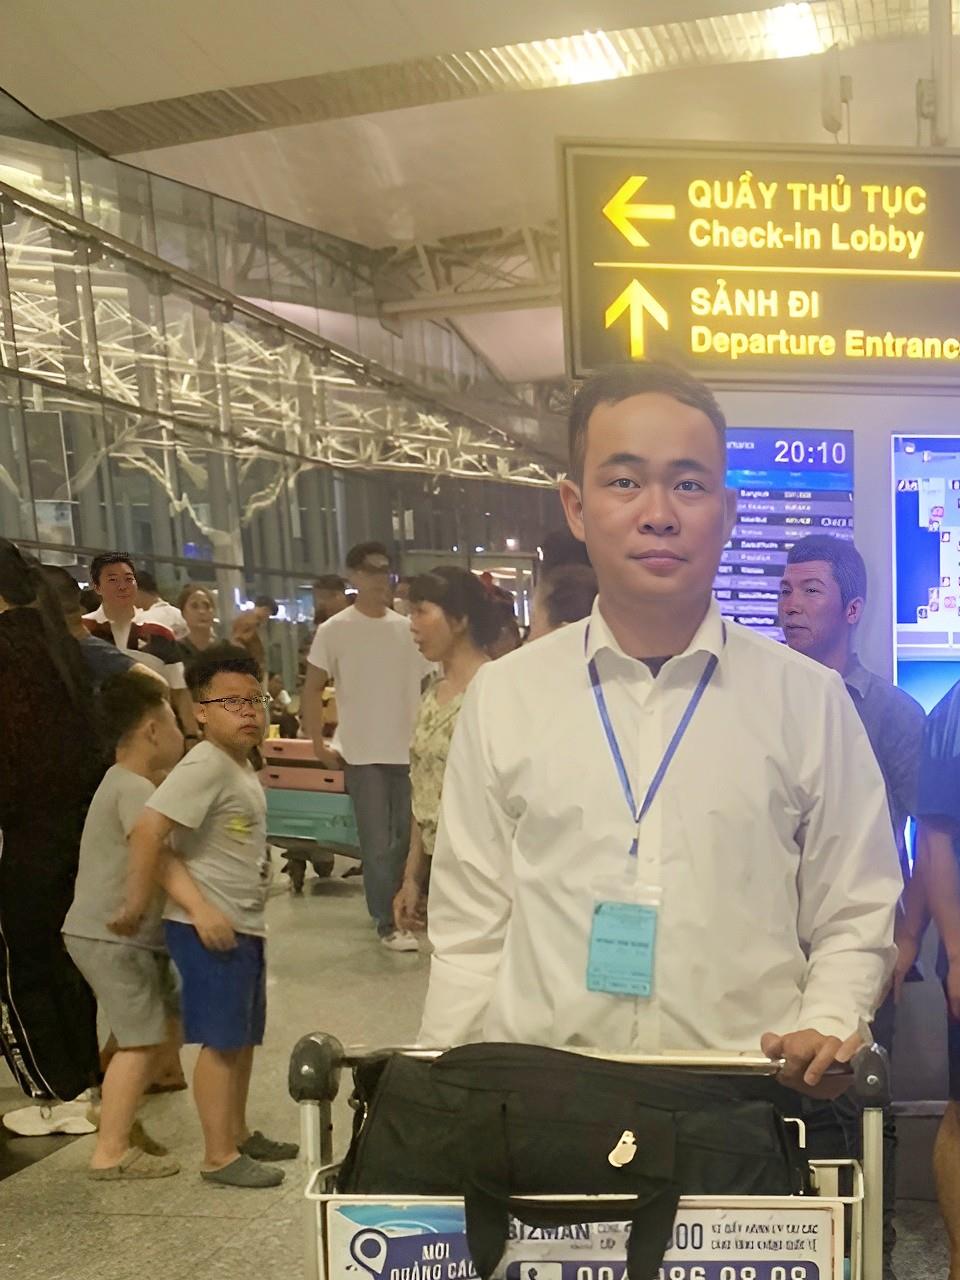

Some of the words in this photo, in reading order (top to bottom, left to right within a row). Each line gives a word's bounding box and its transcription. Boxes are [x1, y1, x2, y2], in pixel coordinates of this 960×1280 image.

[688, 170, 778, 209] QUẦY
[787, 174, 851, 213] THỦ
[861, 185, 927, 218] TỤC
[832, 222, 924, 260] Lobby
[690, 278, 778, 318] SẢNH
[788, 290, 820, 319] ĐI
[690, 325, 836, 360] Departure
[774, 440, 846, 464] 20:10
